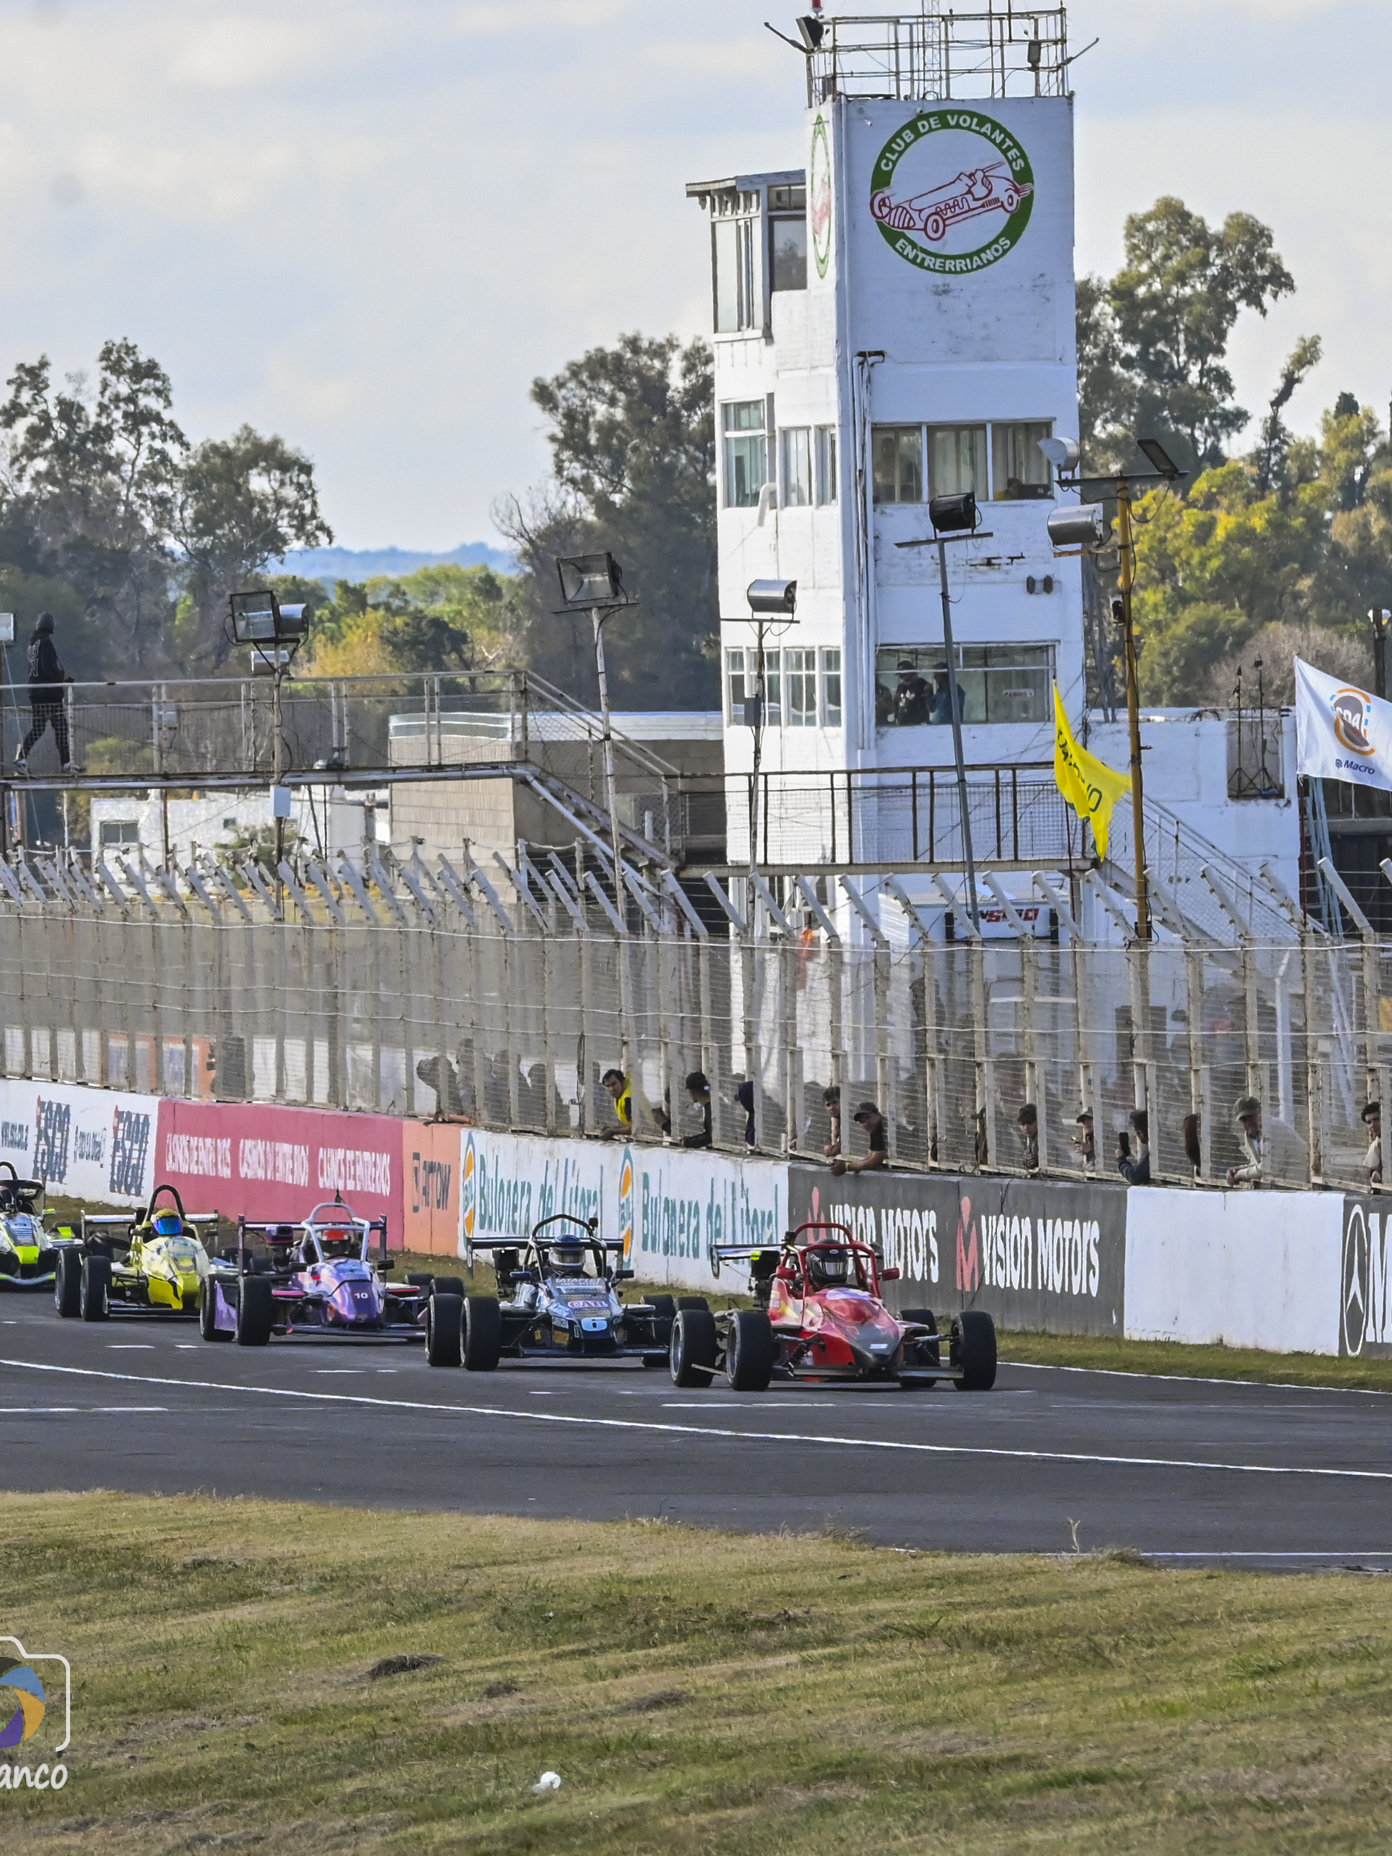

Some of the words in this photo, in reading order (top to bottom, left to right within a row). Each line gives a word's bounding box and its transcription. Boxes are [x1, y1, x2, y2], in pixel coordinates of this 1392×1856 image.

[881, 129, 915, 171] CLUB
[917, 116, 941, 134] DE
[946, 114, 1025, 171] VOLANTES
[895, 237, 1011, 272] ENTRERRIANOS
[1344, 759, 1375, 775] Macro
[479, 1154, 532, 1235] Bulonera
[538, 1157, 559, 1236] del
[642, 1169, 700, 1260] Bulonera
